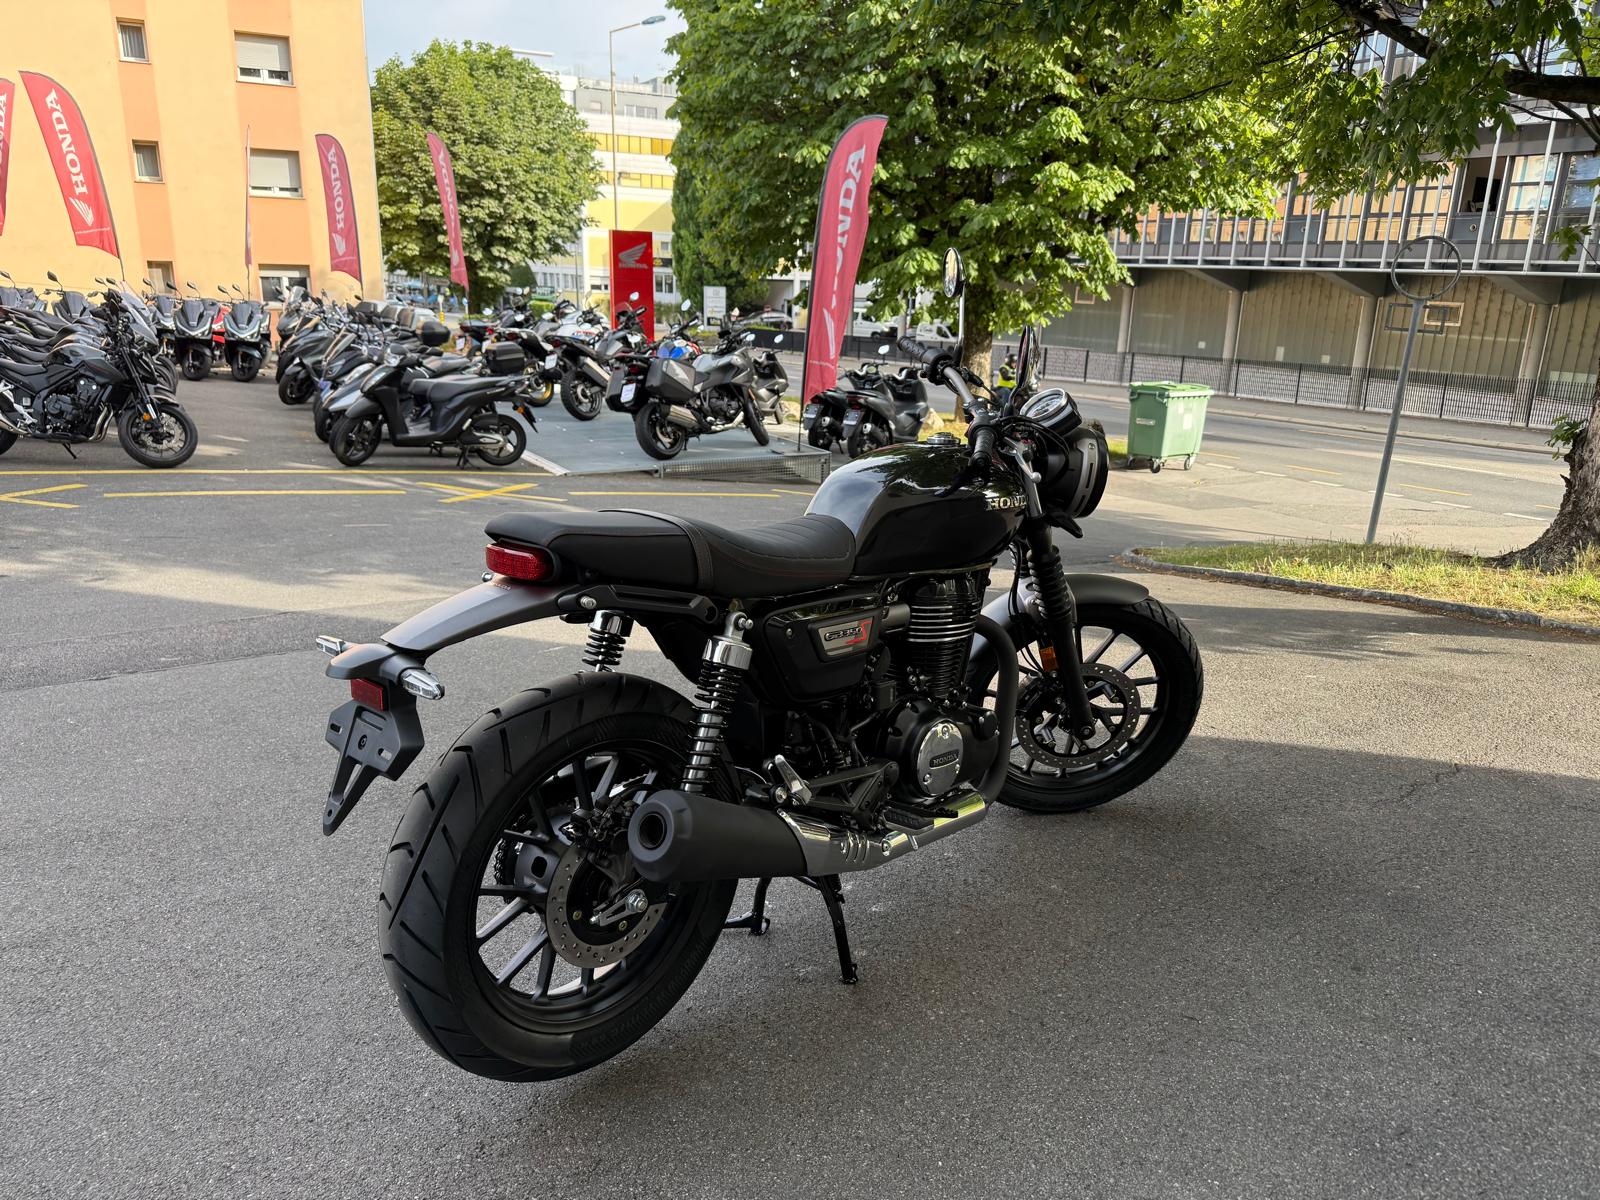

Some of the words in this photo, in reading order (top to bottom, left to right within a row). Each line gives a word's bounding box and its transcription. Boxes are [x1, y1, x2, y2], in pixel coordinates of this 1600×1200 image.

[45, 88, 88, 195] HONDA
[327, 143, 344, 231] HONDA
[438, 148, 455, 239] ONDA
[985, 495, 1027, 511] HOND
[933, 753, 958, 766] HONDA
